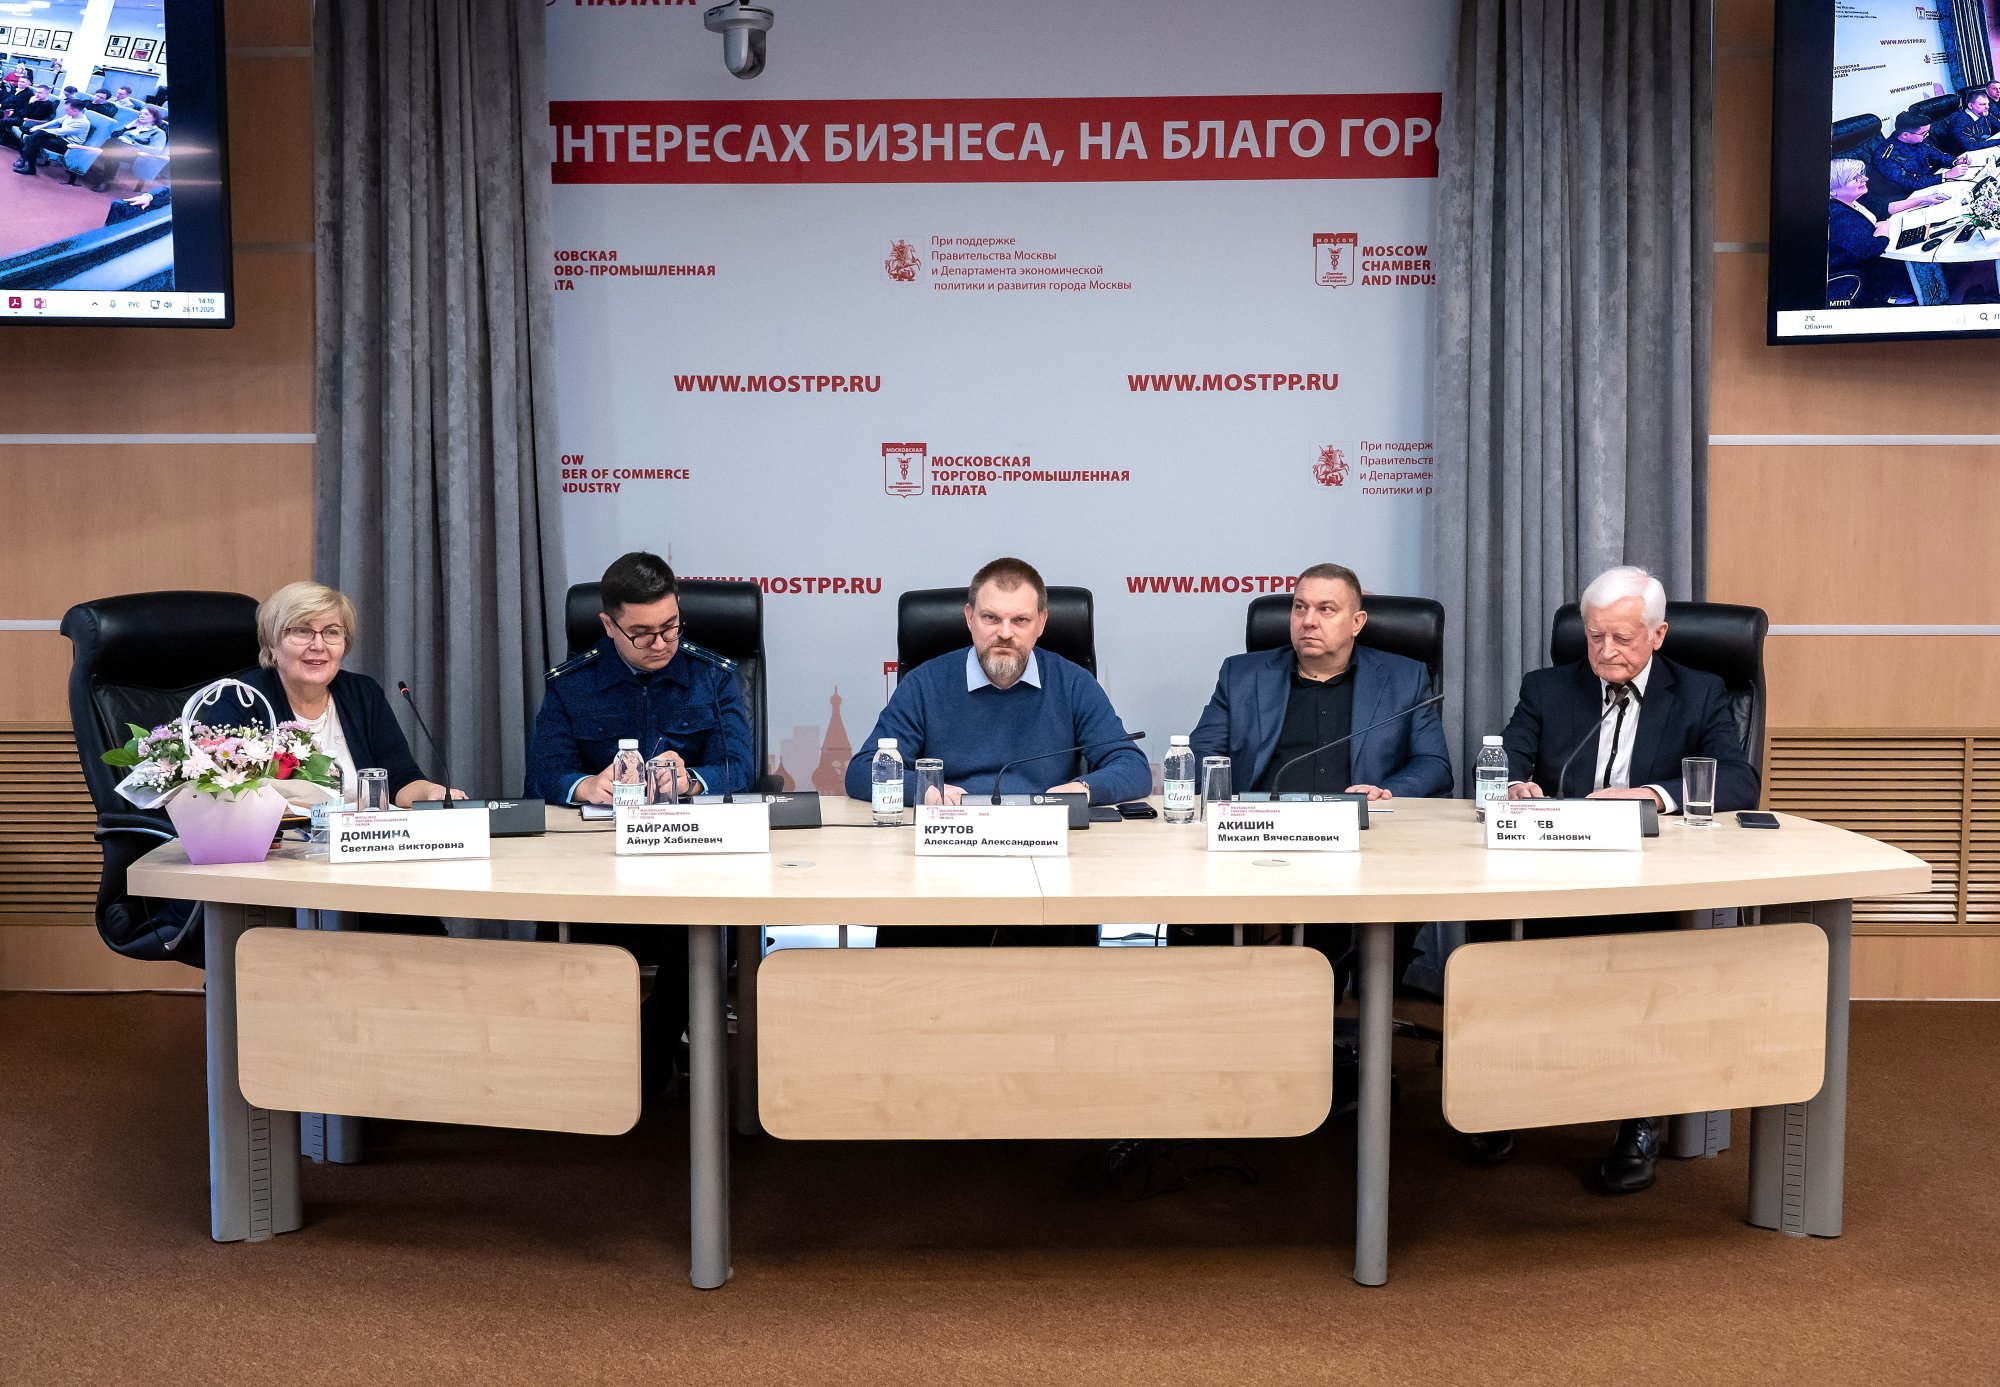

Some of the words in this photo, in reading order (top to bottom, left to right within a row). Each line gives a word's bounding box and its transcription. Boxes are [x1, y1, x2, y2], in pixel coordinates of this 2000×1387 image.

[824, 121, 1065, 167] БИЗНЕСА,
[1079, 121, 1148, 161] НА
[1163, 119, 1326, 160] БЛАГО
[931, 236, 953, 247] При
[956, 237, 1016, 247] поддержке
[1362, 245, 1428, 256] MOSCOW
[931, 251, 1012, 262] Правительства
[1014, 251, 1057, 260] Москвы
[554, 265, 716, 276] ОВО-ПРОМЫШЛЕННАЯ
[941, 265, 1017, 277] Департамента
[1019, 265, 1103, 275] экономической
[1362, 260, 1431, 271] CHAMBER
[1361, 275, 1392, 285] AND
[934, 282, 985, 290] политики
[988, 282, 994, 290] и
[997, 282, 1046, 292] развития
[1049, 282, 1086, 292] города
[1089, 280, 1132, 290] Москвы
[673, 375, 882, 392] WWW.MOSTPP.RU
[1127, 373, 1339, 391] WWW.MOSTPP.RU
[1360, 441, 1381, 452] При
[1385, 442, 1433, 452] поддерж
[561, 455, 584, 465] OW
[931, 456, 1031, 467] МОСКОВСКАЯ
[1360, 456, 1433, 467] Правительств
[562, 469, 588, 479] BER
[591, 469, 609, 479] OF
[612, 469, 690, 479] COMMERCE
[931, 470, 1130, 481] ТОРГОВО-ПРОМЫШЛЕННАЯ
[1369, 470, 1433, 482] Департамен
[931, 485, 987, 495] ПАЛАТА
[676, 577, 882, 594] MOSTPP.RU
[626, 822, 700, 833] БАЙРАМОВ
[924, 825, 974, 834] КРУТОВ
[1217, 821, 1274, 830] АКИШИН
[340, 829, 411, 842] ДОМНИНА
[626, 837, 660, 846] Айнур
[663, 836, 723, 844] Хабилевич
[1217, 834, 1260, 842] Михаил
[1263, 834, 1339, 842] Вячеславович
[341, 844, 395, 853] Светлана
[398, 842, 465, 851] Викторовна
[924, 838, 978, 846] Александр
[980, 838, 1058, 847] Александрович
